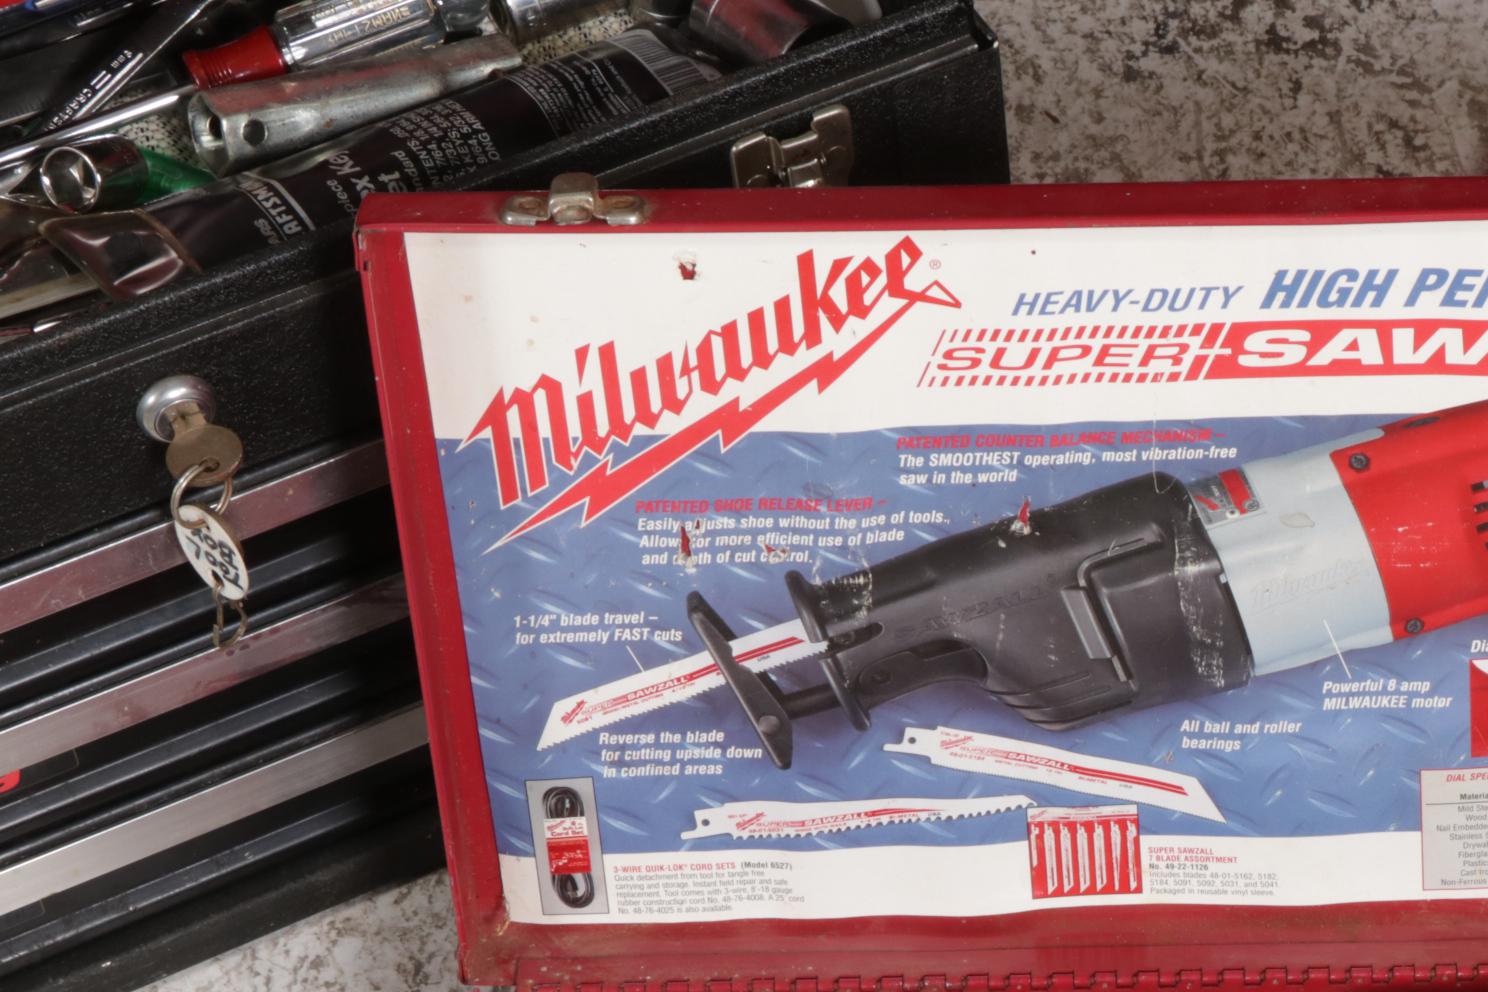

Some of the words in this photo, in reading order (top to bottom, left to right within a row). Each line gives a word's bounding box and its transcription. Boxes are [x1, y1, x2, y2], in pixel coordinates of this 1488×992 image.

[1011, 286, 1244, 315] HEAVY-DUTY
[1260, 269, 1398, 308] HIGH
[936, 343, 1192, 371] SUPER
[456, 235, 925, 510] Milwaukee
[896, 436, 971, 449] PATENTED
[975, 434, 1045, 447] COUNTER
[1049, 431, 1116, 447] BALANCE
[1120, 429, 1212, 444] MECHANISM
[898, 453, 924, 467] The
[929, 452, 1021, 468] SMOOTHEST
[1024, 450, 1096, 468] operating,
[1101, 449, 1137, 462] most
[1141, 446, 1238, 461] vibration-free
[898, 473, 928, 486] saw
[932, 471, 946, 484] in
[950, 471, 973, 483] the
[977, 469, 1017, 483] world
[635, 500, 709, 512] PATENTED
[714, 498, 752, 512] SHOE
[827, 496, 873, 512] LEVER
[637, 517, 682, 533] Easily
[739, 515, 774, 529] shoe
[778, 515, 830, 529] without
[834, 516, 857, 529] the
[860, 514, 886, 528] use
[890, 510, 905, 524] of
[714, 535, 752, 546] more
[756, 532, 814, 548] efficient
[817, 535, 843, 546] use
[847, 532, 862, 546] of
[865, 528, 904, 544] blade
[641, 551, 668, 564] and
[716, 550, 730, 563] of
[734, 549, 756, 562] cut
[560, 612, 599, 626] blade
[604, 611, 644, 624] travel
[515, 632, 536, 644] for
[539, 630, 610, 646] extremely
[613, 628, 651, 642] FAST
[653, 629, 683, 643] cuts
[1322, 679, 1384, 694] Powerful
[1387, 679, 1397, 692] 8
[1399, 682, 1431, 696] amp
[1322, 696, 1408, 709] MILWAUKEE
[1411, 696, 1452, 708] motor
[1180, 719, 1200, 732] All
[1203, 720, 1230, 733] ball
[1233, 721, 1260, 734] and
[1263, 720, 1302, 733] roller
[598, 732, 655, 744] Reverse
[659, 731, 681, 743] the
[686, 729, 724, 743] blade
[1181, 736, 1241, 752] bearings
[600, 749, 620, 761] for
[624, 747, 672, 762] cutting
[675, 746, 722, 761] upside
[726, 745, 762, 758] down
[602, 765, 617, 777] in
[620, 763, 681, 776] confined
[684, 764, 723, 775] areas
[1446, 773, 1466, 782] DIAL
